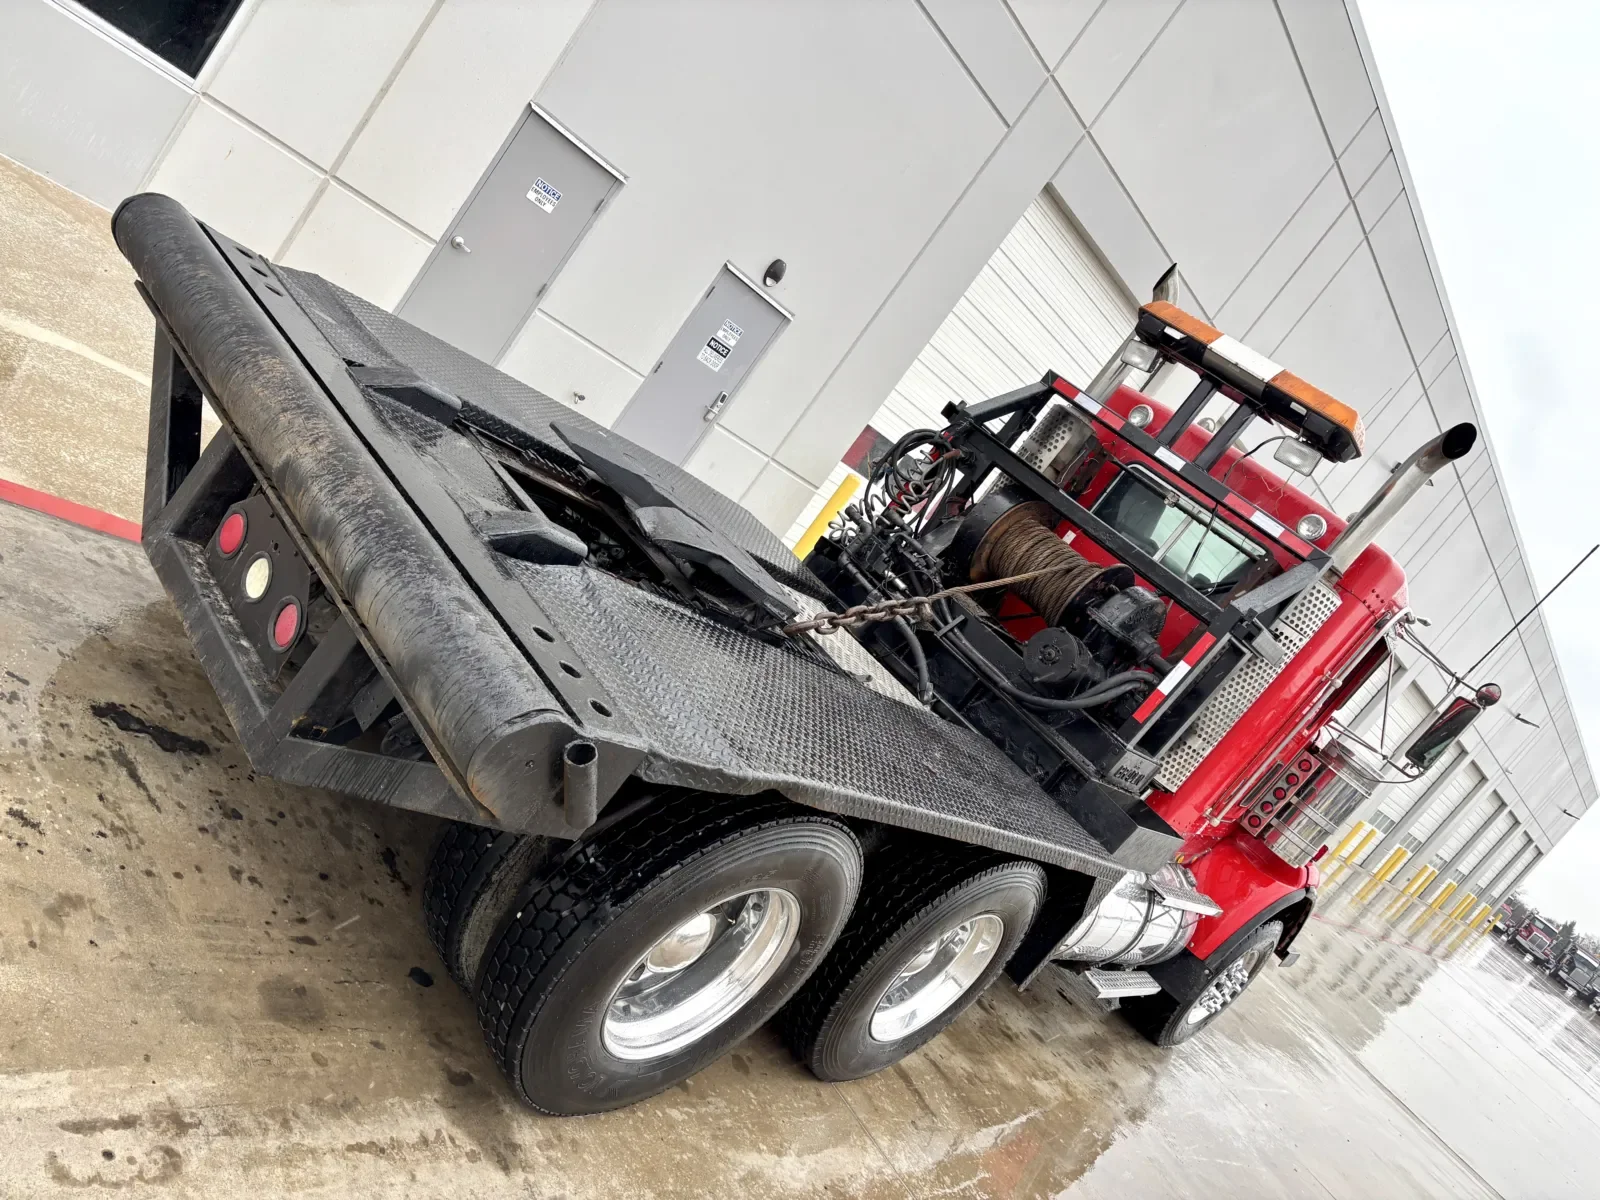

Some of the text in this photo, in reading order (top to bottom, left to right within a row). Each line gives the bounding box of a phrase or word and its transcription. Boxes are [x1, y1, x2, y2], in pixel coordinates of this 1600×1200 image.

[531, 187, 556, 207] EMPLOYEES
[536, 180, 560, 200] NOTICE
[535, 197, 546, 207] ONLY
[724, 321, 743, 336] NOTICE
[708, 339, 729, 356] NOTICE
